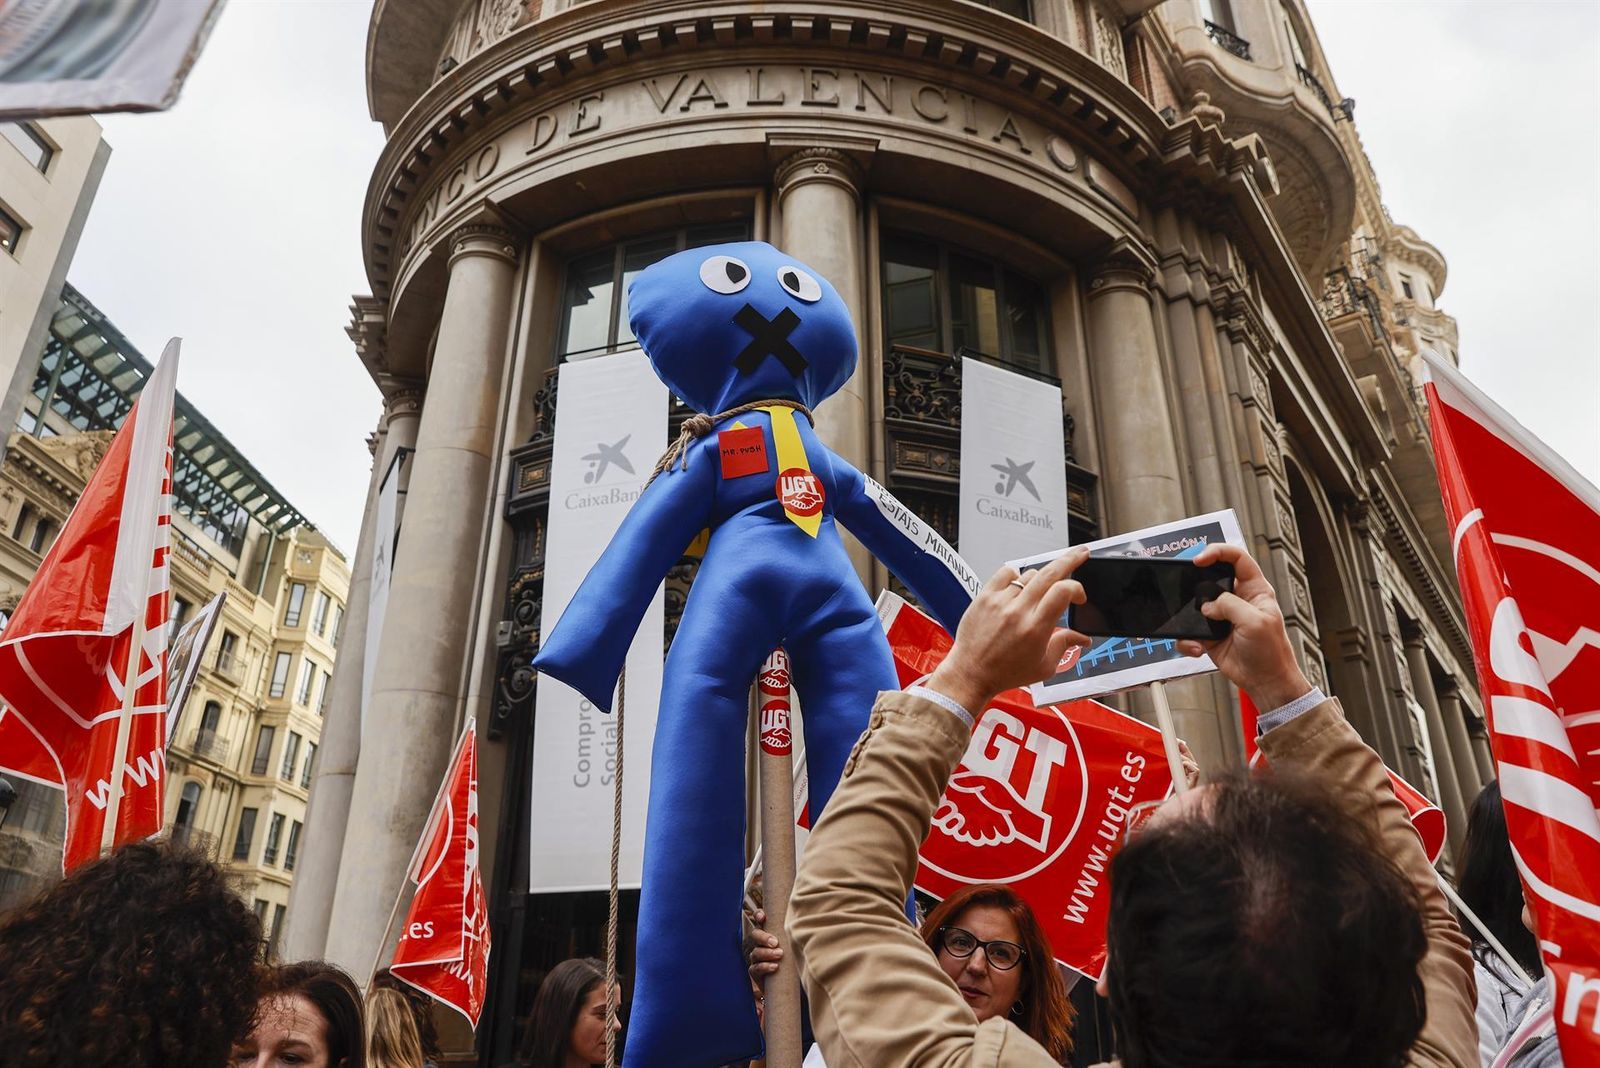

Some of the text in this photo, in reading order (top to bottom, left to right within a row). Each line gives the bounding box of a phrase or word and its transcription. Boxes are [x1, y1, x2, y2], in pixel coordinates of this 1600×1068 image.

[525, 91, 604, 156] DE
[642, 66, 1032, 156] VALENCIA
[564, 486, 644, 510] CaixaBan
[781, 475, 818, 496] UGT
[976, 498, 1054, 530] CaixaBank
[573, 699, 596, 788] Compro
[600, 720, 617, 786] Social
[961, 707, 1068, 813] GT
[85, 747, 166, 810] ww
[1062, 751, 1146, 924] www.ugt.es
[399, 921, 434, 942] .es
